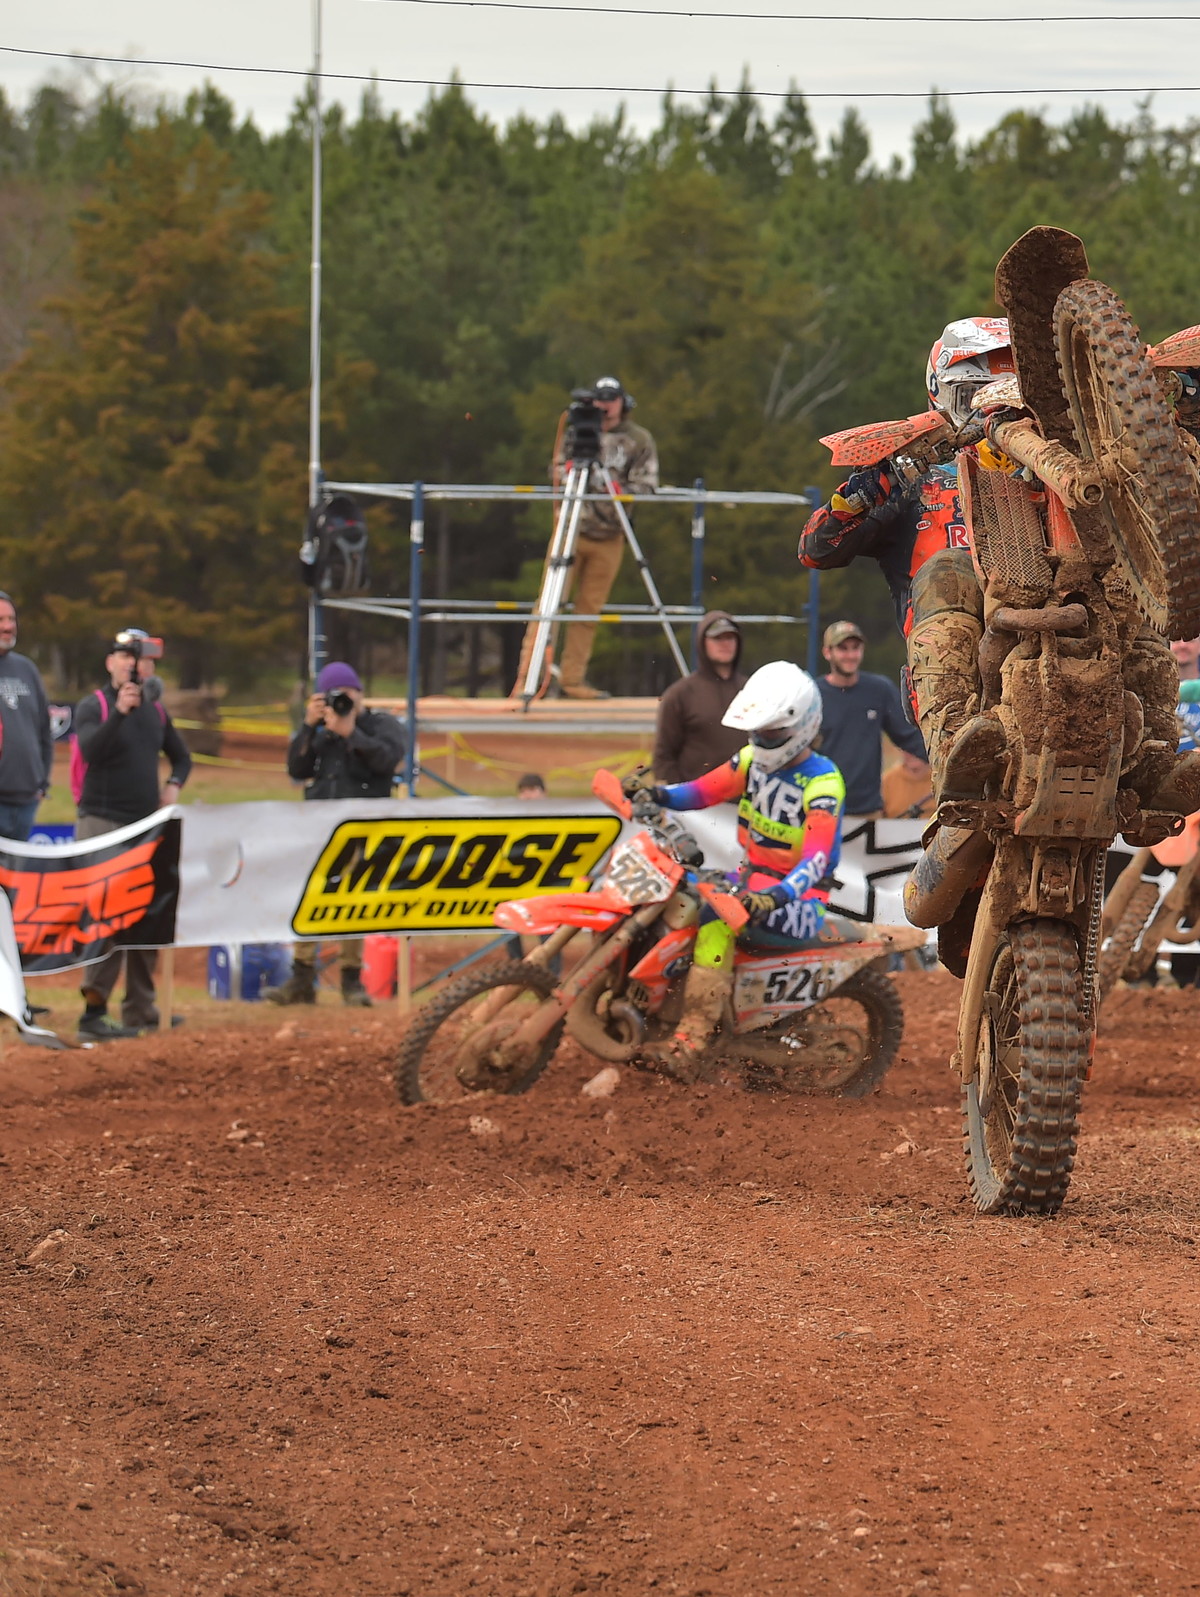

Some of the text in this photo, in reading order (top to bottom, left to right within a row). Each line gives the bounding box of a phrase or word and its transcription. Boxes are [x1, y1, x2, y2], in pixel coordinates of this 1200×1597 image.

[322, 834, 600, 894] MOOSE
[608, 851, 662, 904] 526
[309, 897, 504, 922] UTILITY DIVIS
[766, 900, 817, 939] FXR
